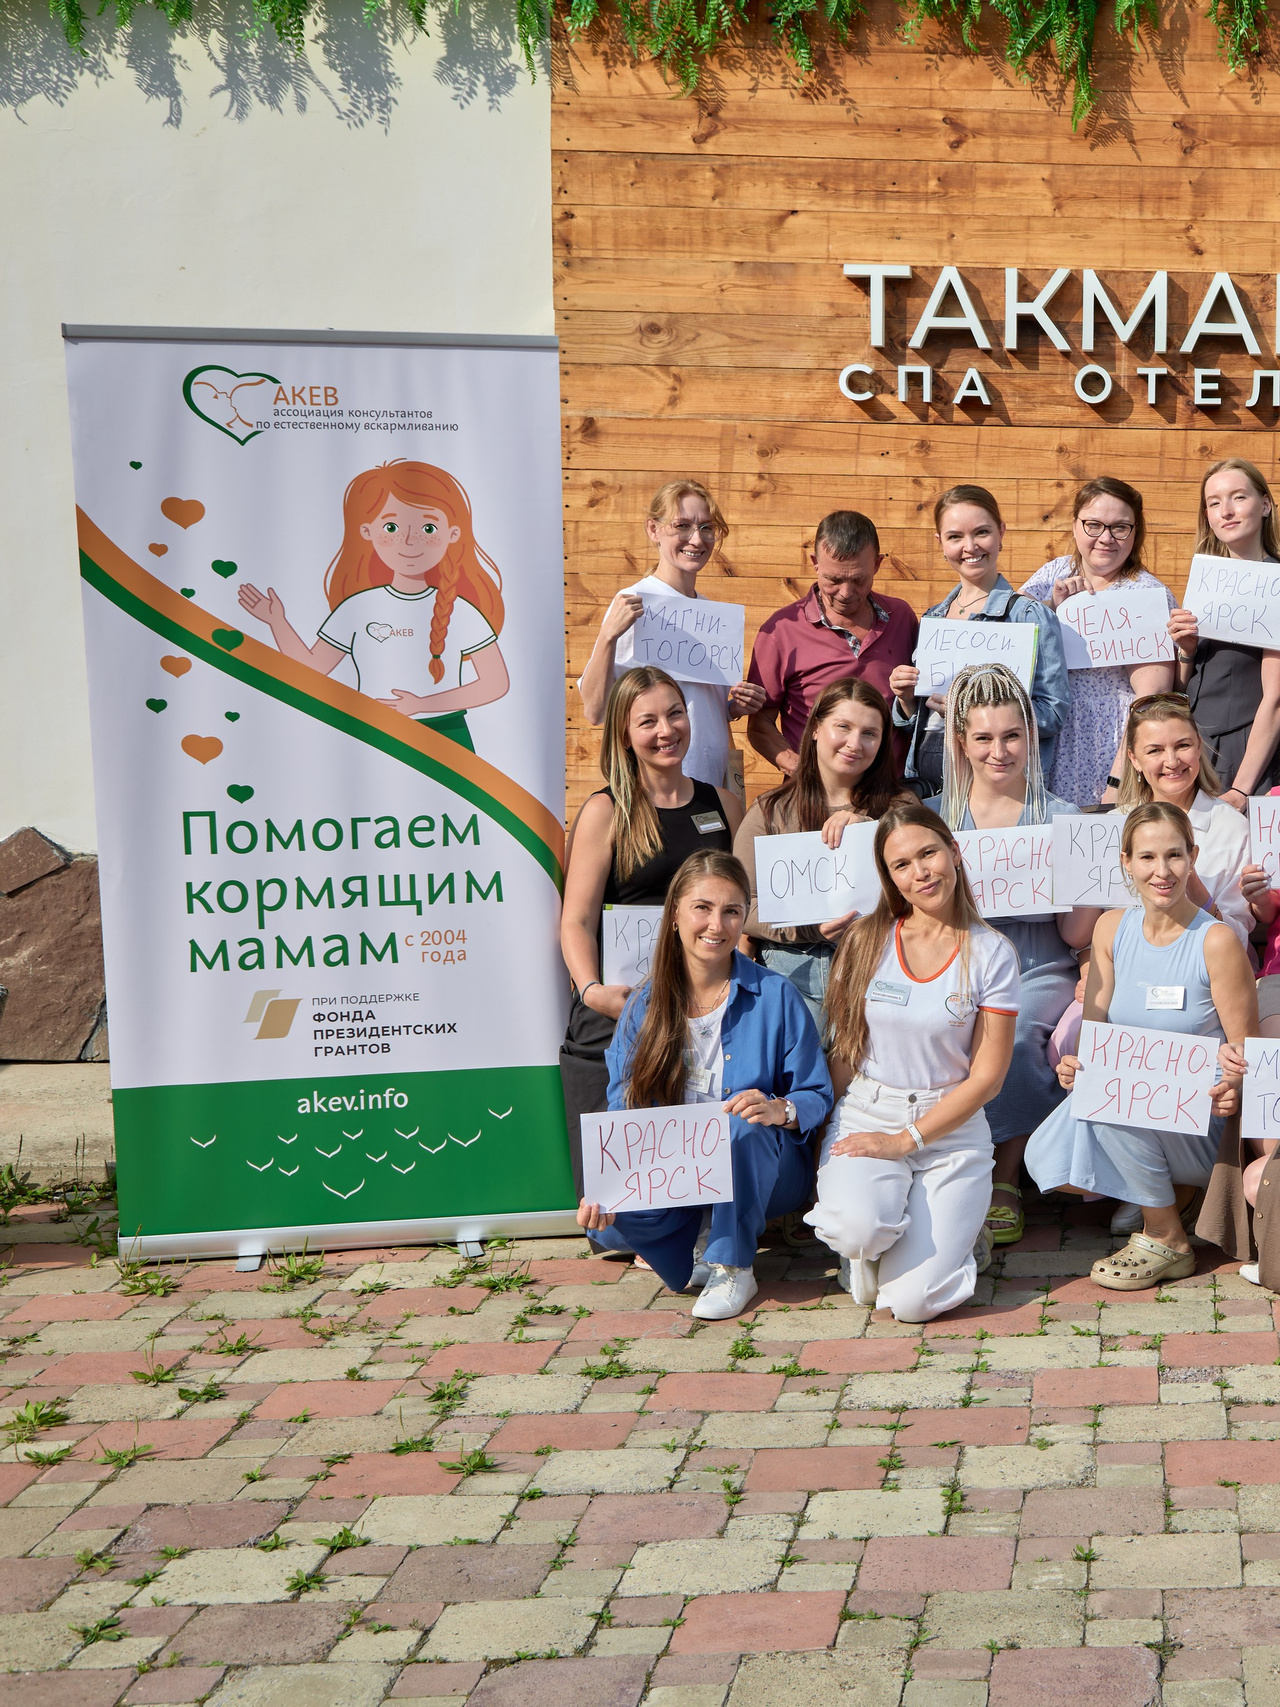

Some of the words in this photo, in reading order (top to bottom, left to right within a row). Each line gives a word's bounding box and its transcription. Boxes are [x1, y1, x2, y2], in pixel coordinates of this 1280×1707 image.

[273, 386, 339, 406] АКЕВ
[838, 363, 992, 406] СПА
[256, 421, 270, 429] по
[273, 421, 360, 433] естественному
[364, 421, 459, 433] вскармливанию
[273, 408, 343, 418] ассоциация
[348, 408, 433, 421] консультантов
[390, 628, 414, 637] АКЕВ
[643, 605, 726, 634] МАГНИ-
[1066, 605, 1142, 637] ЧЕЛЯ-
[1198, 601, 1273, 639] ЯРСК
[641, 638, 742, 673] ТОГОРСК
[925, 629, 1015, 651] ЛЕСОСИ-
[1090, 631, 1171, 661] БИНСК
[182, 811, 481, 856] Помогаем
[1070, 823, 1120, 862] КРА
[770, 854, 855, 899] ОМСК
[1075, 865, 1125, 898] ЯР
[185, 869, 504, 930] кормящим
[189, 931, 399, 973] мамам
[405, 934, 414, 947] с
[420, 929, 467, 946] 2004
[615, 915, 662, 960] КРА
[421, 949, 467, 965] года
[312, 997, 337, 1006] ПРИ
[340, 993, 420, 1005] ПОДДЕРЖКЕ
[312, 1009, 376, 1023] ФОНДА
[313, 1023, 457, 1040] ПРЕЗИДЕНТСКИХ
[314, 1043, 391, 1057] ГРАНТОВ
[1091, 1027, 1210, 1076] КРАСНО-
[297, 1087, 409, 1114] akev.info
[1087, 1078, 1199, 1129] ЯРСК
[599, 1118, 726, 1174] КРАСНО-
[609, 1165, 721, 1211] ЯРСК
